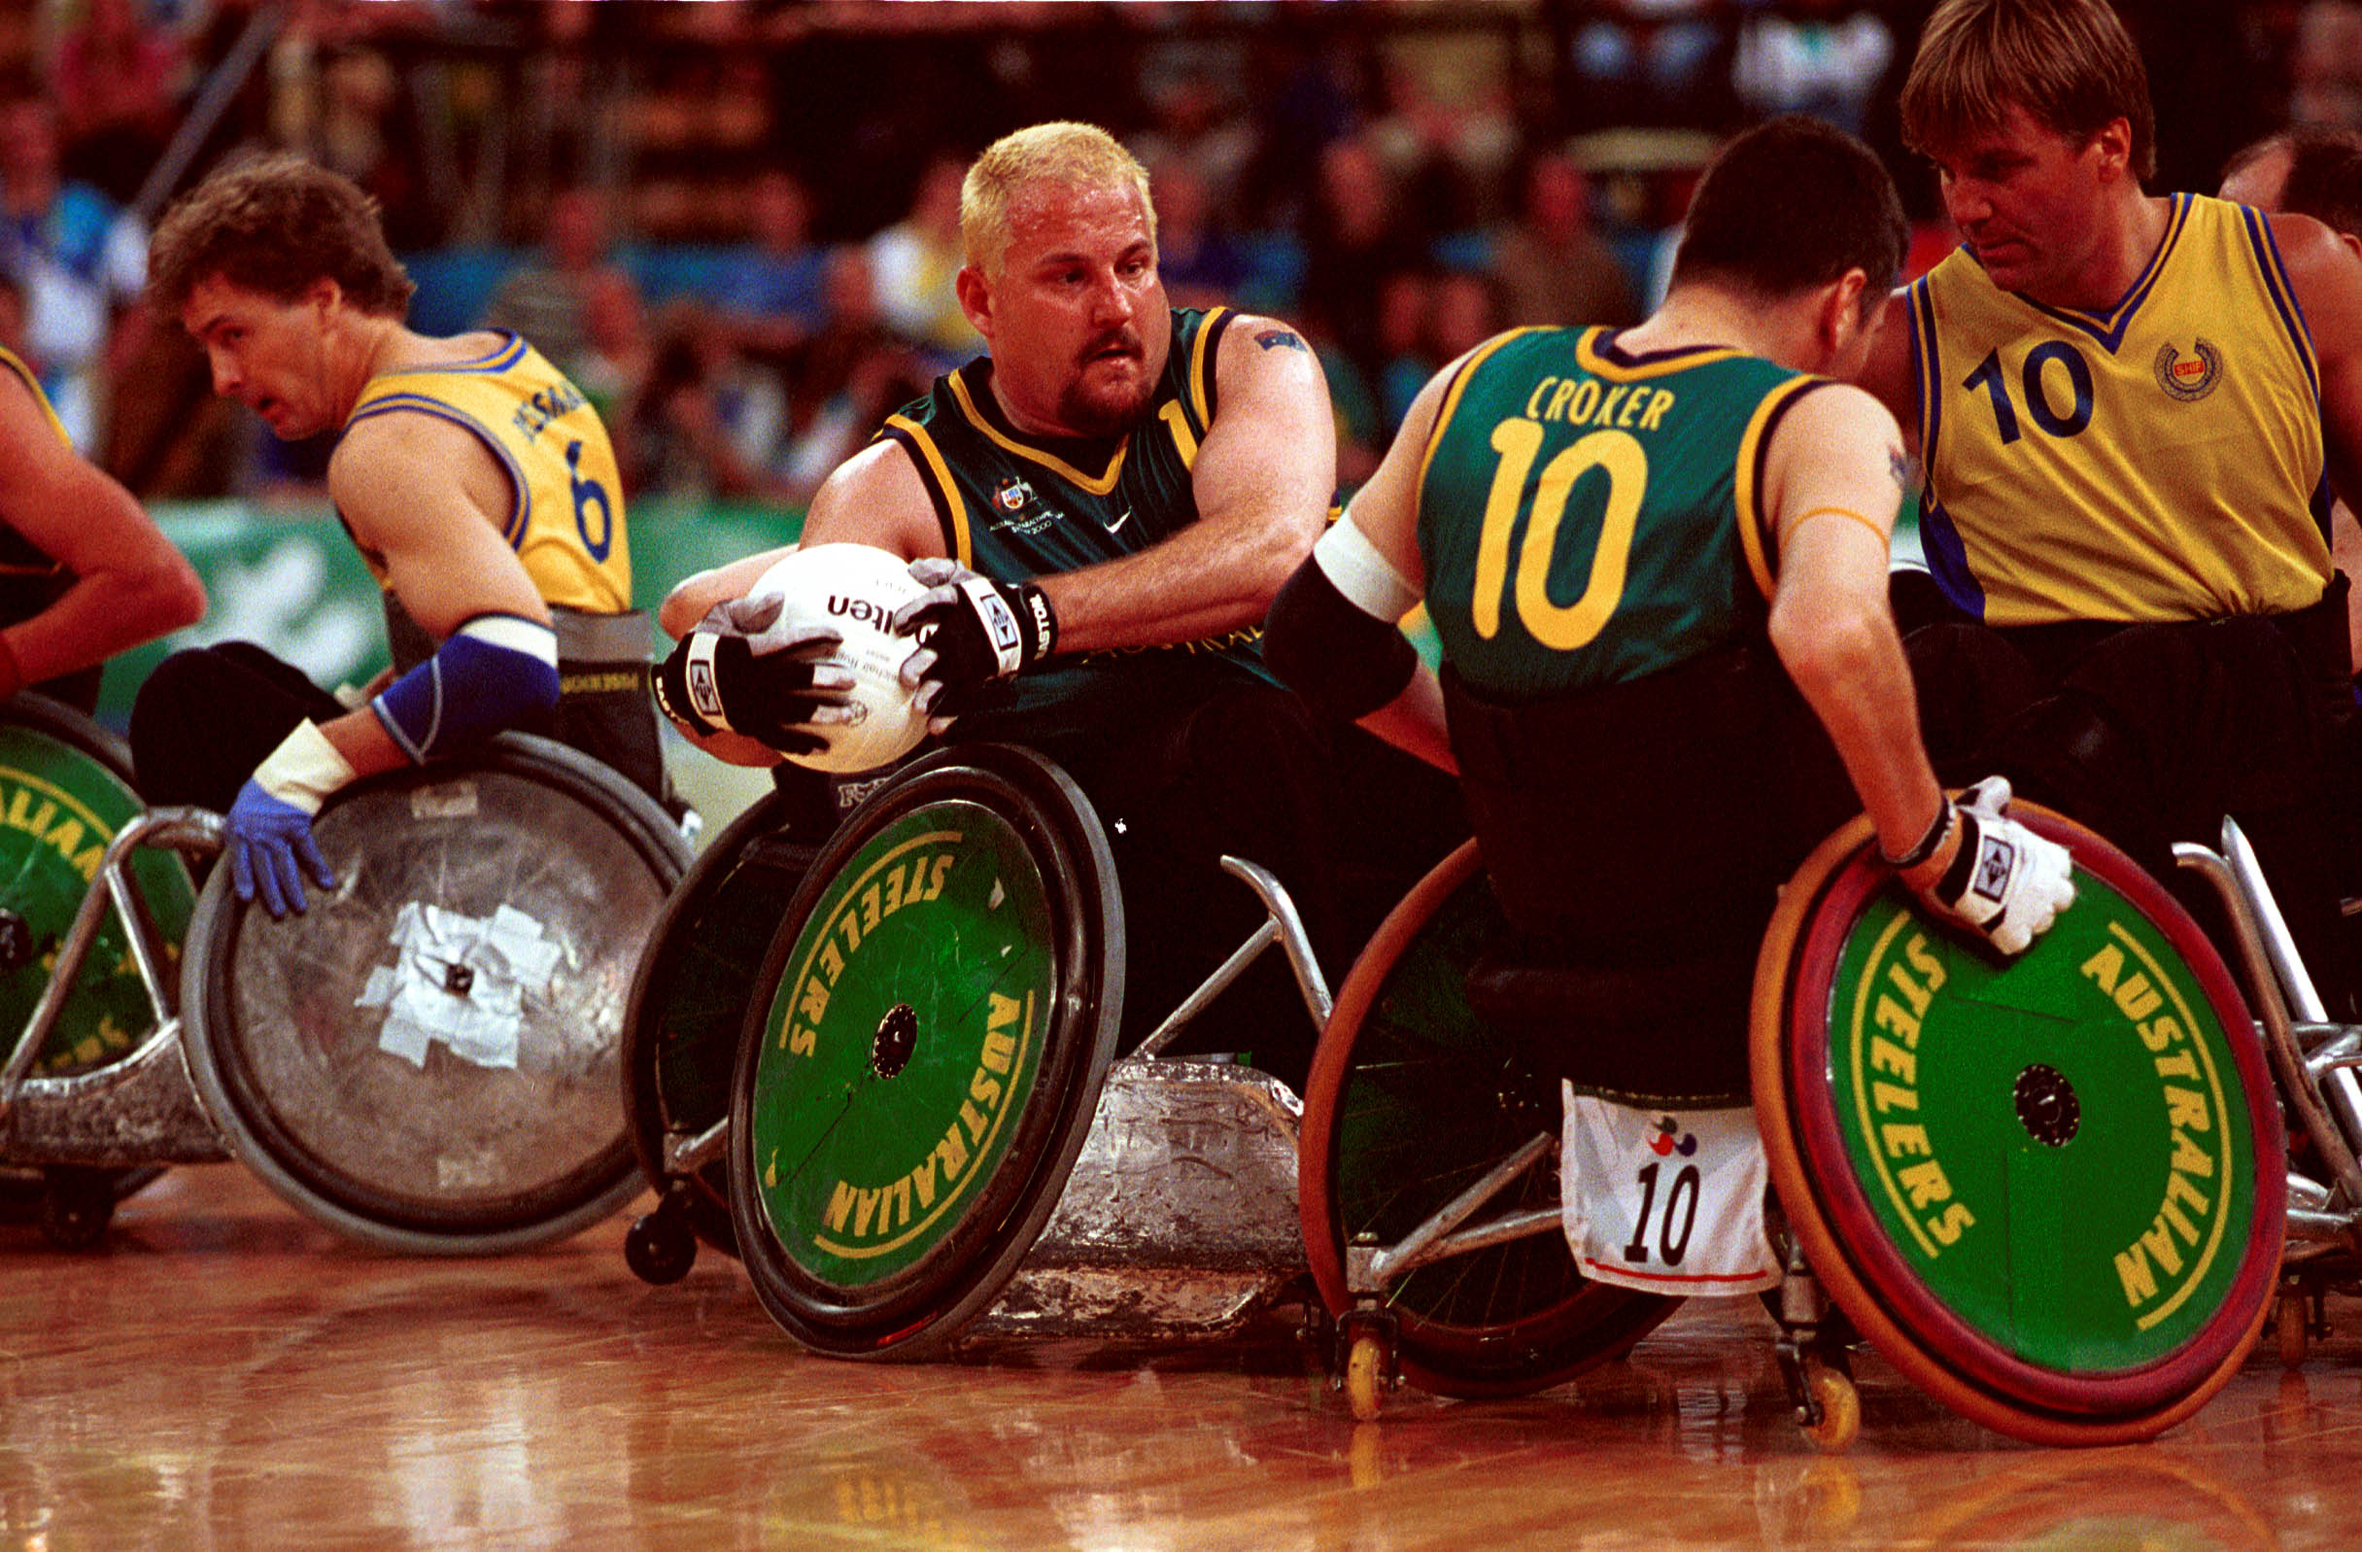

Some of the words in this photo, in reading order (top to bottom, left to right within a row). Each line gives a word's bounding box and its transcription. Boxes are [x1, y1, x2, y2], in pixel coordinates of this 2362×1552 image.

[1526, 376, 1675, 431] CROKER
[1962, 340, 2094, 445] 10
[566, 440, 612, 564] 6
[1472, 417, 1648, 651] 10
[827, 594, 894, 635] lten
[789, 855, 955, 1058] STEELERS
[823, 992, 1021, 1237] AUSTRALIAN
[1870, 933, 1976, 1247] STEELERS
[2080, 942, 2213, 1307] AUSTRALIAN
[1624, 1162, 1700, 1267] 10
